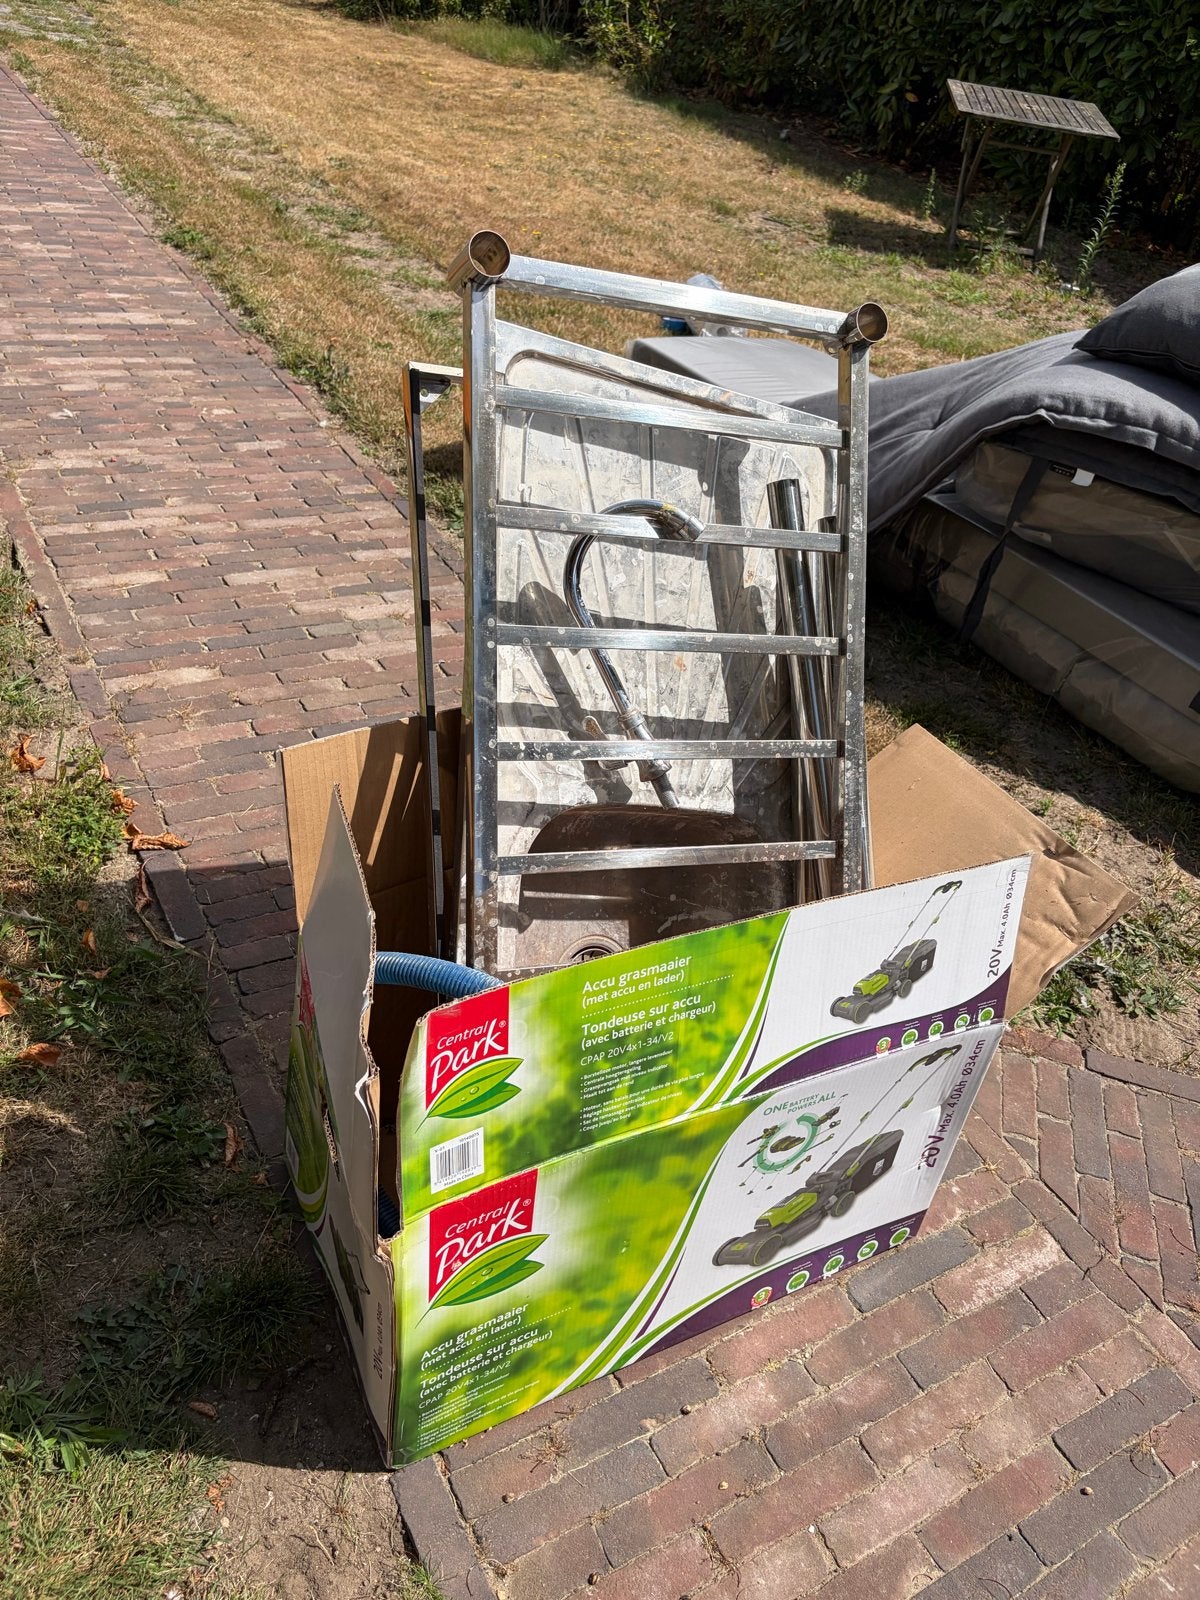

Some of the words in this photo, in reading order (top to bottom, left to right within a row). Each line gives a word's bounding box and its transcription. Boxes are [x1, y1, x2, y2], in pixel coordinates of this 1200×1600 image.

[987, 949, 1002, 978] 20V
[1002, 903, 1010, 926] 4.0Ah
[582, 977, 614, 993] Accu
[618, 956, 692, 986] grasmaaier
[582, 992, 608, 1009] (met
[611, 986, 635, 998] accu
[638, 981, 650, 991] en
[654, 970, 684, 986] lader)
[437, 1021, 488, 1049] Central
[581, 1034, 609, 1050] (avec
[612, 1020, 652, 1038] batterie
[656, 1016, 666, 1026] et
[669, 1001, 716, 1022] chargeur)
[582, 1010, 646, 1036] Tondeuse
[649, 1004, 669, 1016] sur
[672, 995, 701, 1010] accu
[430, 1018, 504, 1094] Park
[580, 1052, 604, 1066] CPAP
[608, 1032, 674, 1058] 20V4x1-34/V2
[764, 1101, 788, 1116] ONE
[789, 1093, 820, 1107] BATTERY
[817, 1091, 836, 1103] ALL
[787, 1100, 816, 1114] POWERS
[938, 1111, 954, 1133] Max.
[948, 1080, 967, 1108] 4.0Ah
[435, 1198, 528, 1285] Park
[445, 1201, 510, 1238] Central
[421, 1340, 452, 1361] Accu
[456, 1304, 528, 1344] grasmaaier
[421, 1354, 449, 1371] (met
[449, 1340, 472, 1354] accu
[476, 1332, 488, 1341] en
[491, 1315, 521, 1334] lader)
[420, 1354, 483, 1388] Tondeuse
[486, 1342, 506, 1356] sur
[510, 1329, 538, 1345] accu
[420, 1380, 447, 1398] (avec
[450, 1359, 490, 1382] batterie
[492, 1354, 503, 1362] et
[506, 1330, 552, 1356] chargeur)
[419, 1393, 442, 1409] CPAP
